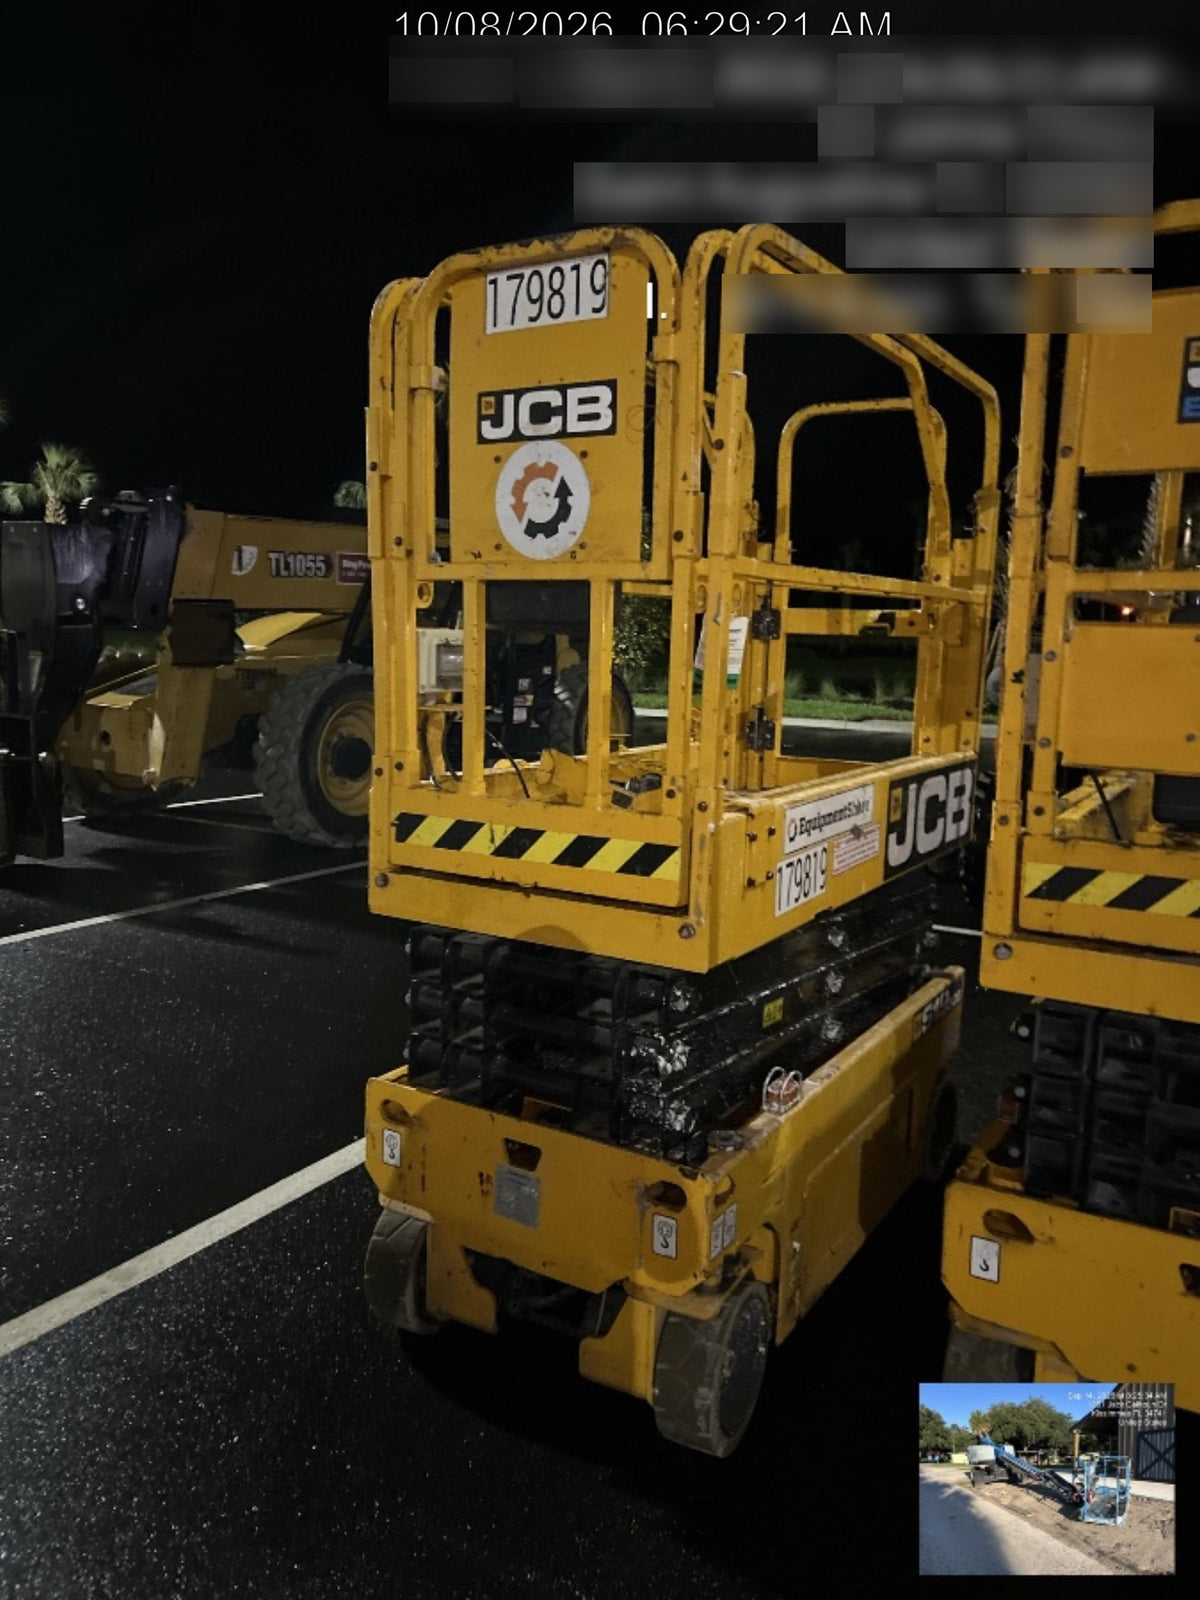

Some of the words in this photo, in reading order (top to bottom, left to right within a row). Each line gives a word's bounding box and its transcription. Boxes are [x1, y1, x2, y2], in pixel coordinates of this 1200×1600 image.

[488, 258, 607, 328] 179819
[481, 385, 613, 440] JCB
[268, 552, 326, 577] TL1055
[887, 767, 973, 867] JCB
[776, 847, 828, 911] 179819
